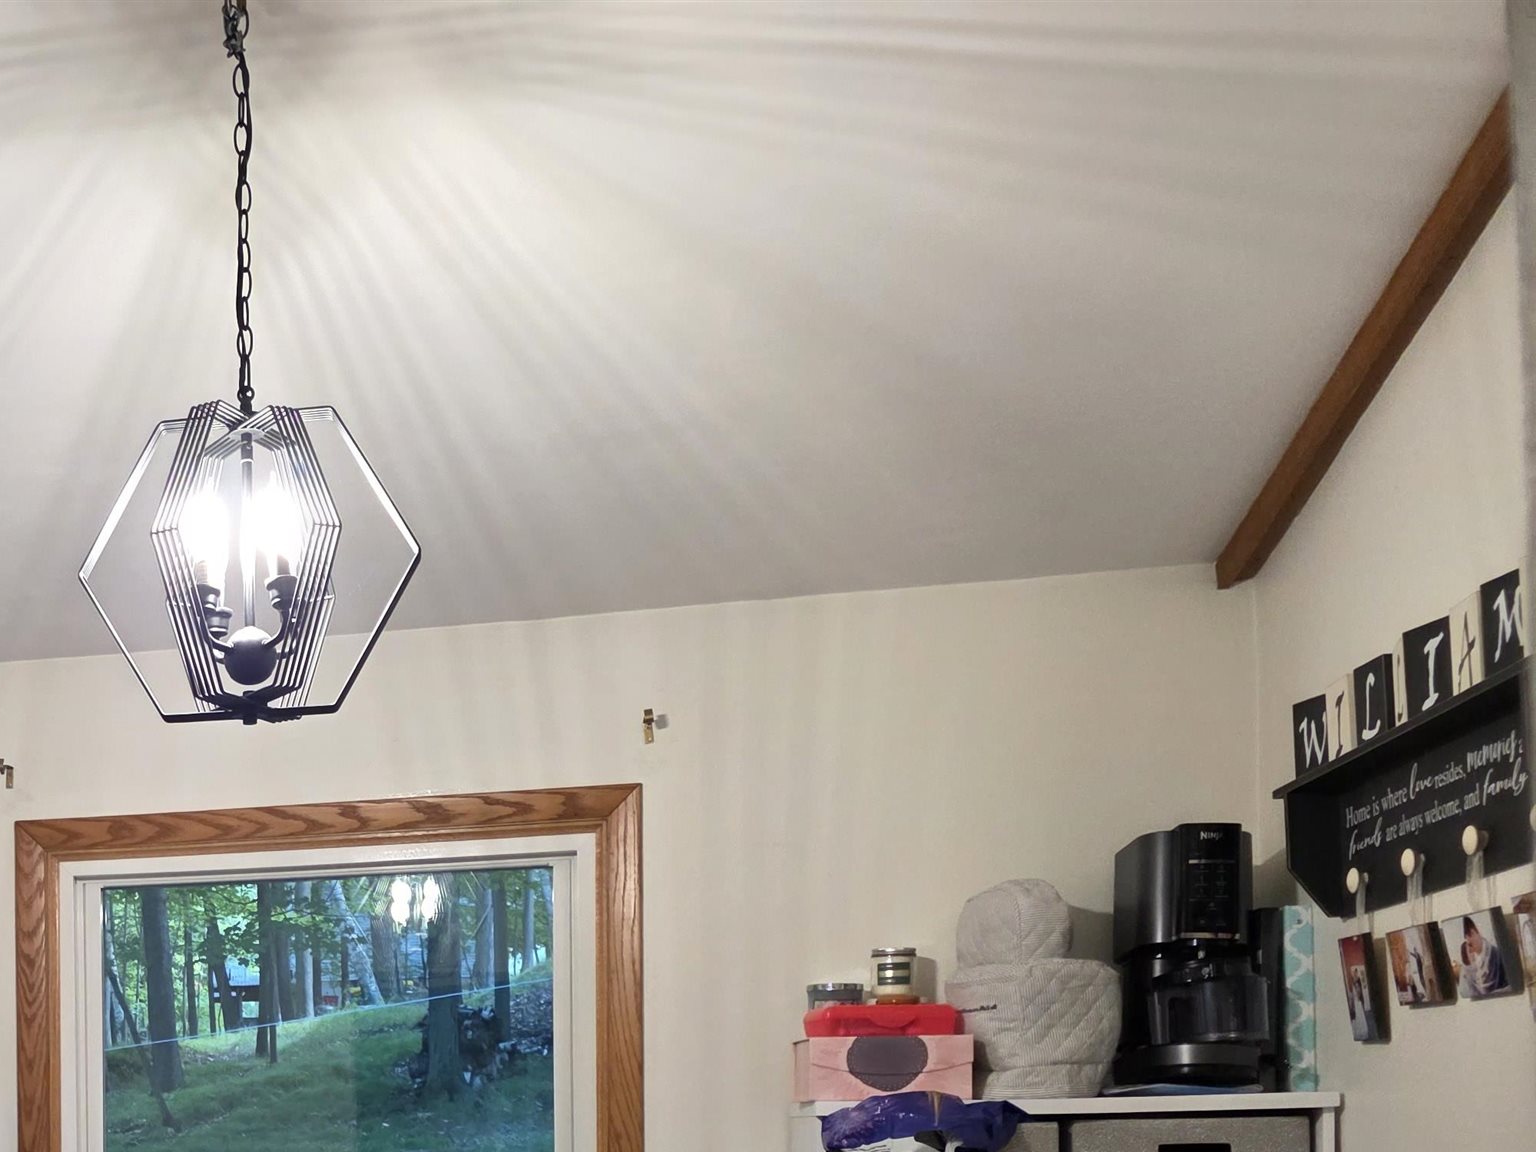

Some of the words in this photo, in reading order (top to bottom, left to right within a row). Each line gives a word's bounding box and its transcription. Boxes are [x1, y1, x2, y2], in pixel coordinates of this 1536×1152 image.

[1346, 805, 1371, 828] Home
[1372, 796, 1380, 816] is
[1381, 787, 1408, 812] where
[1409, 762, 1434, 800] love
[1467, 730, 1517, 773] memories
[1348, 816, 1382, 860] friends
[1385, 822, 1399, 842] are
[1399, 814, 1424, 836] always
[1463, 783, 1480, 811] and
[1482, 756, 1528, 806] family
